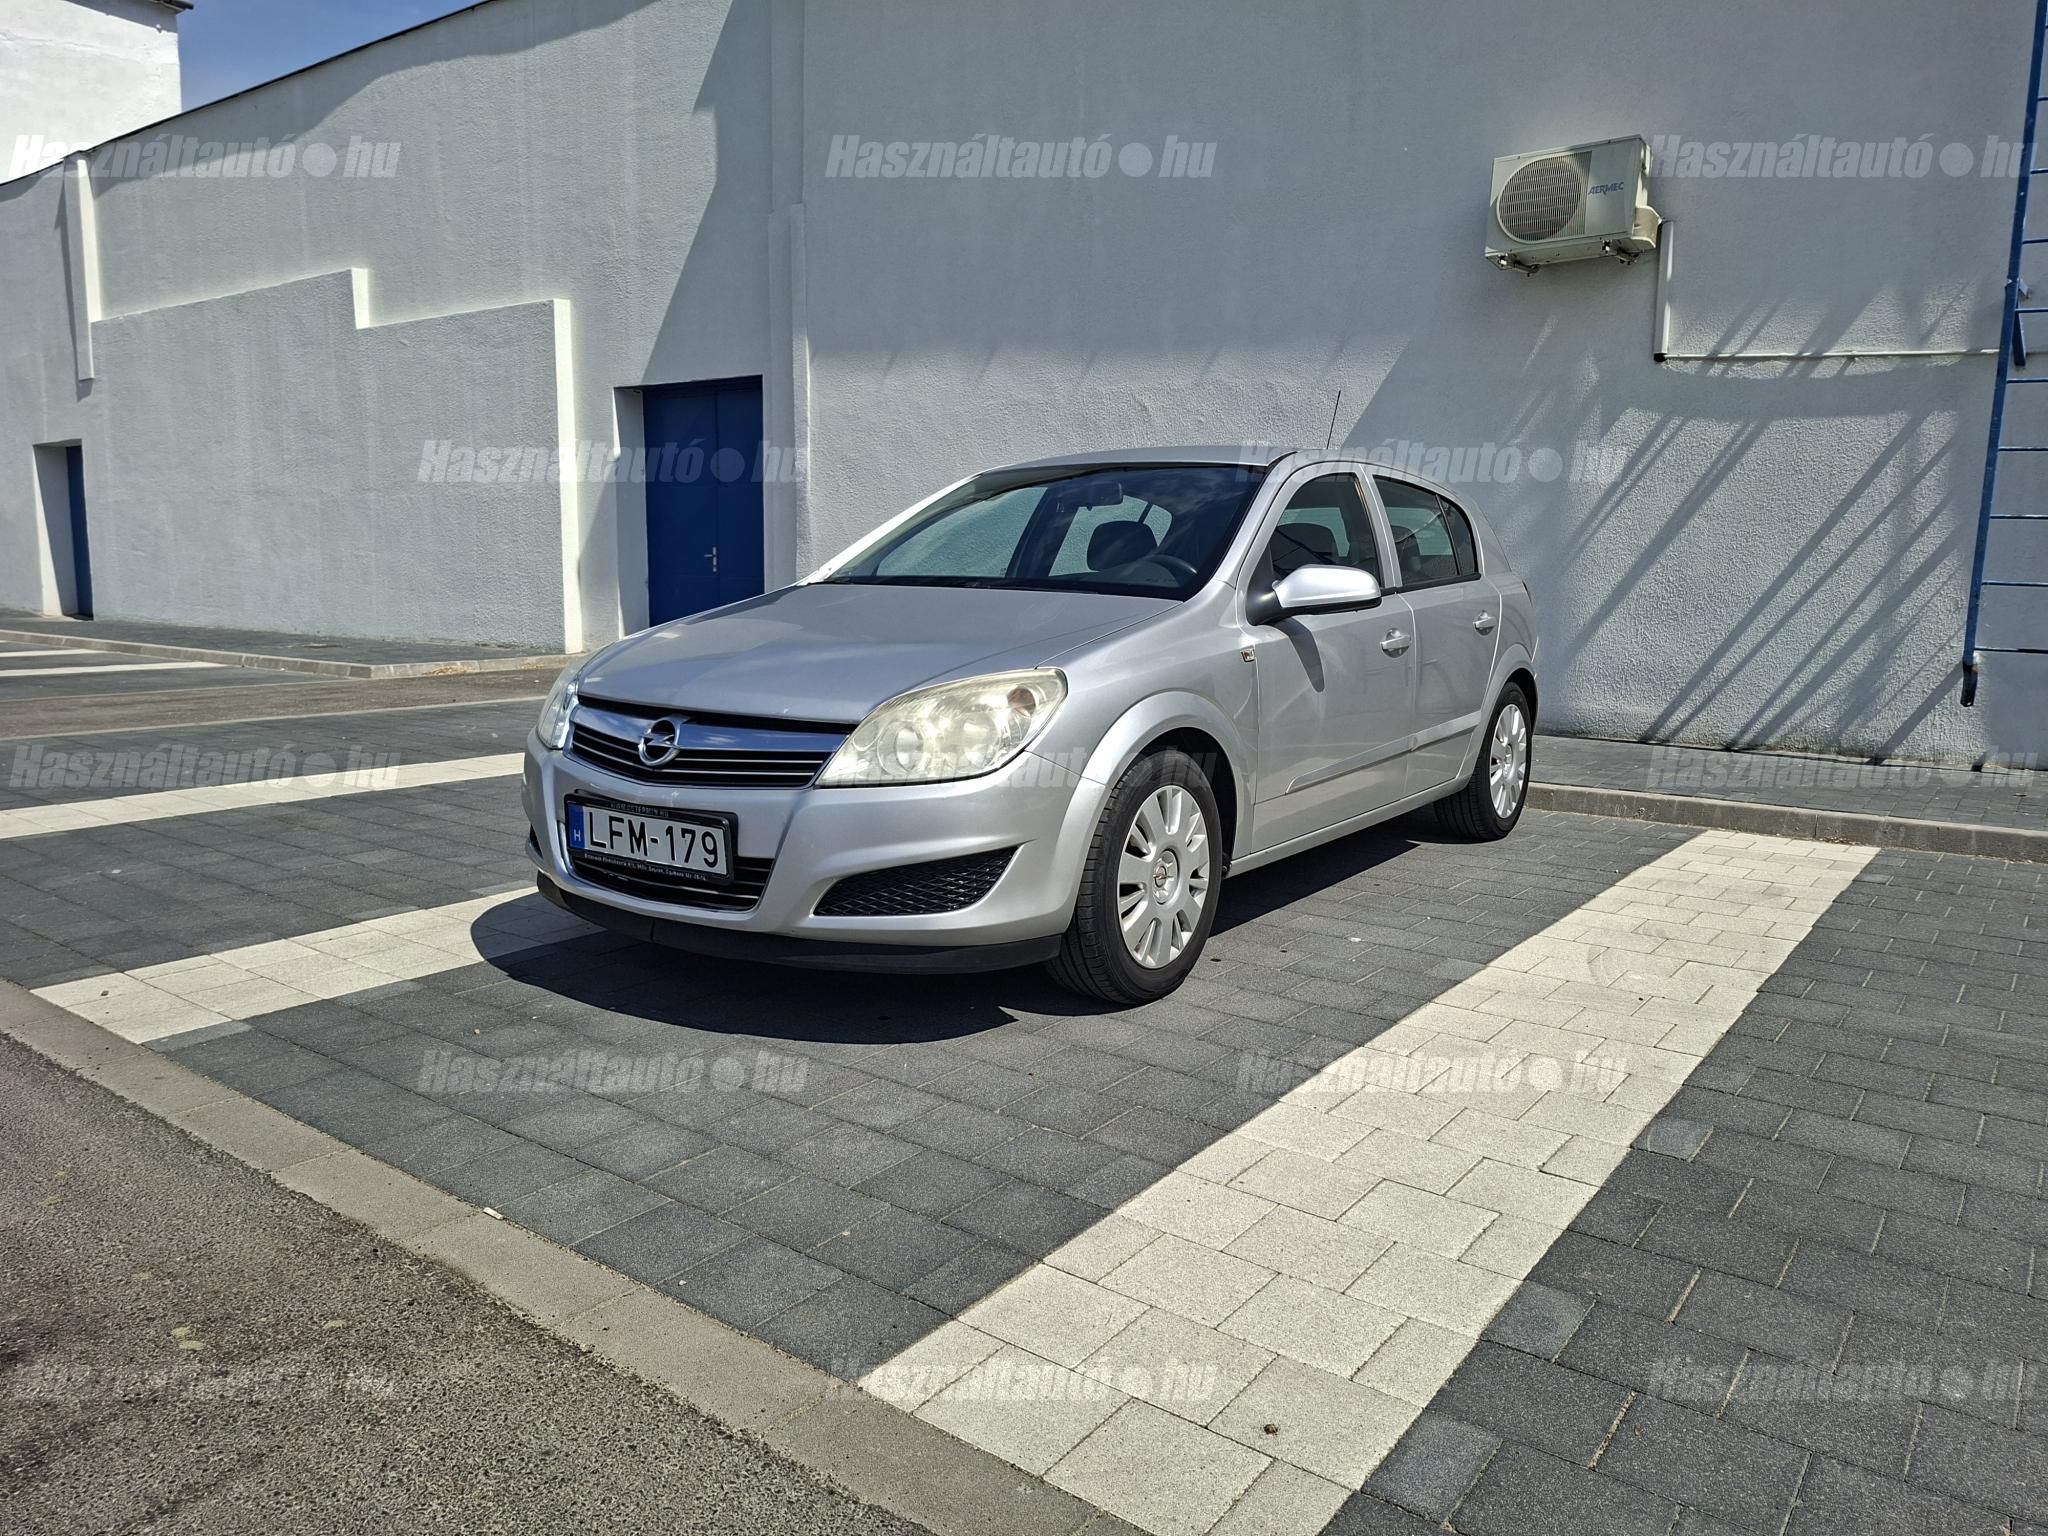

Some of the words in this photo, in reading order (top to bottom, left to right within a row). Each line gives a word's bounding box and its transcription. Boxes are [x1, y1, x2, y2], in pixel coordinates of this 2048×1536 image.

[1588, 182, 1624, 195] AERMEC
[573, 829, 581, 842] H
[589, 811, 719, 868] LFM-179
